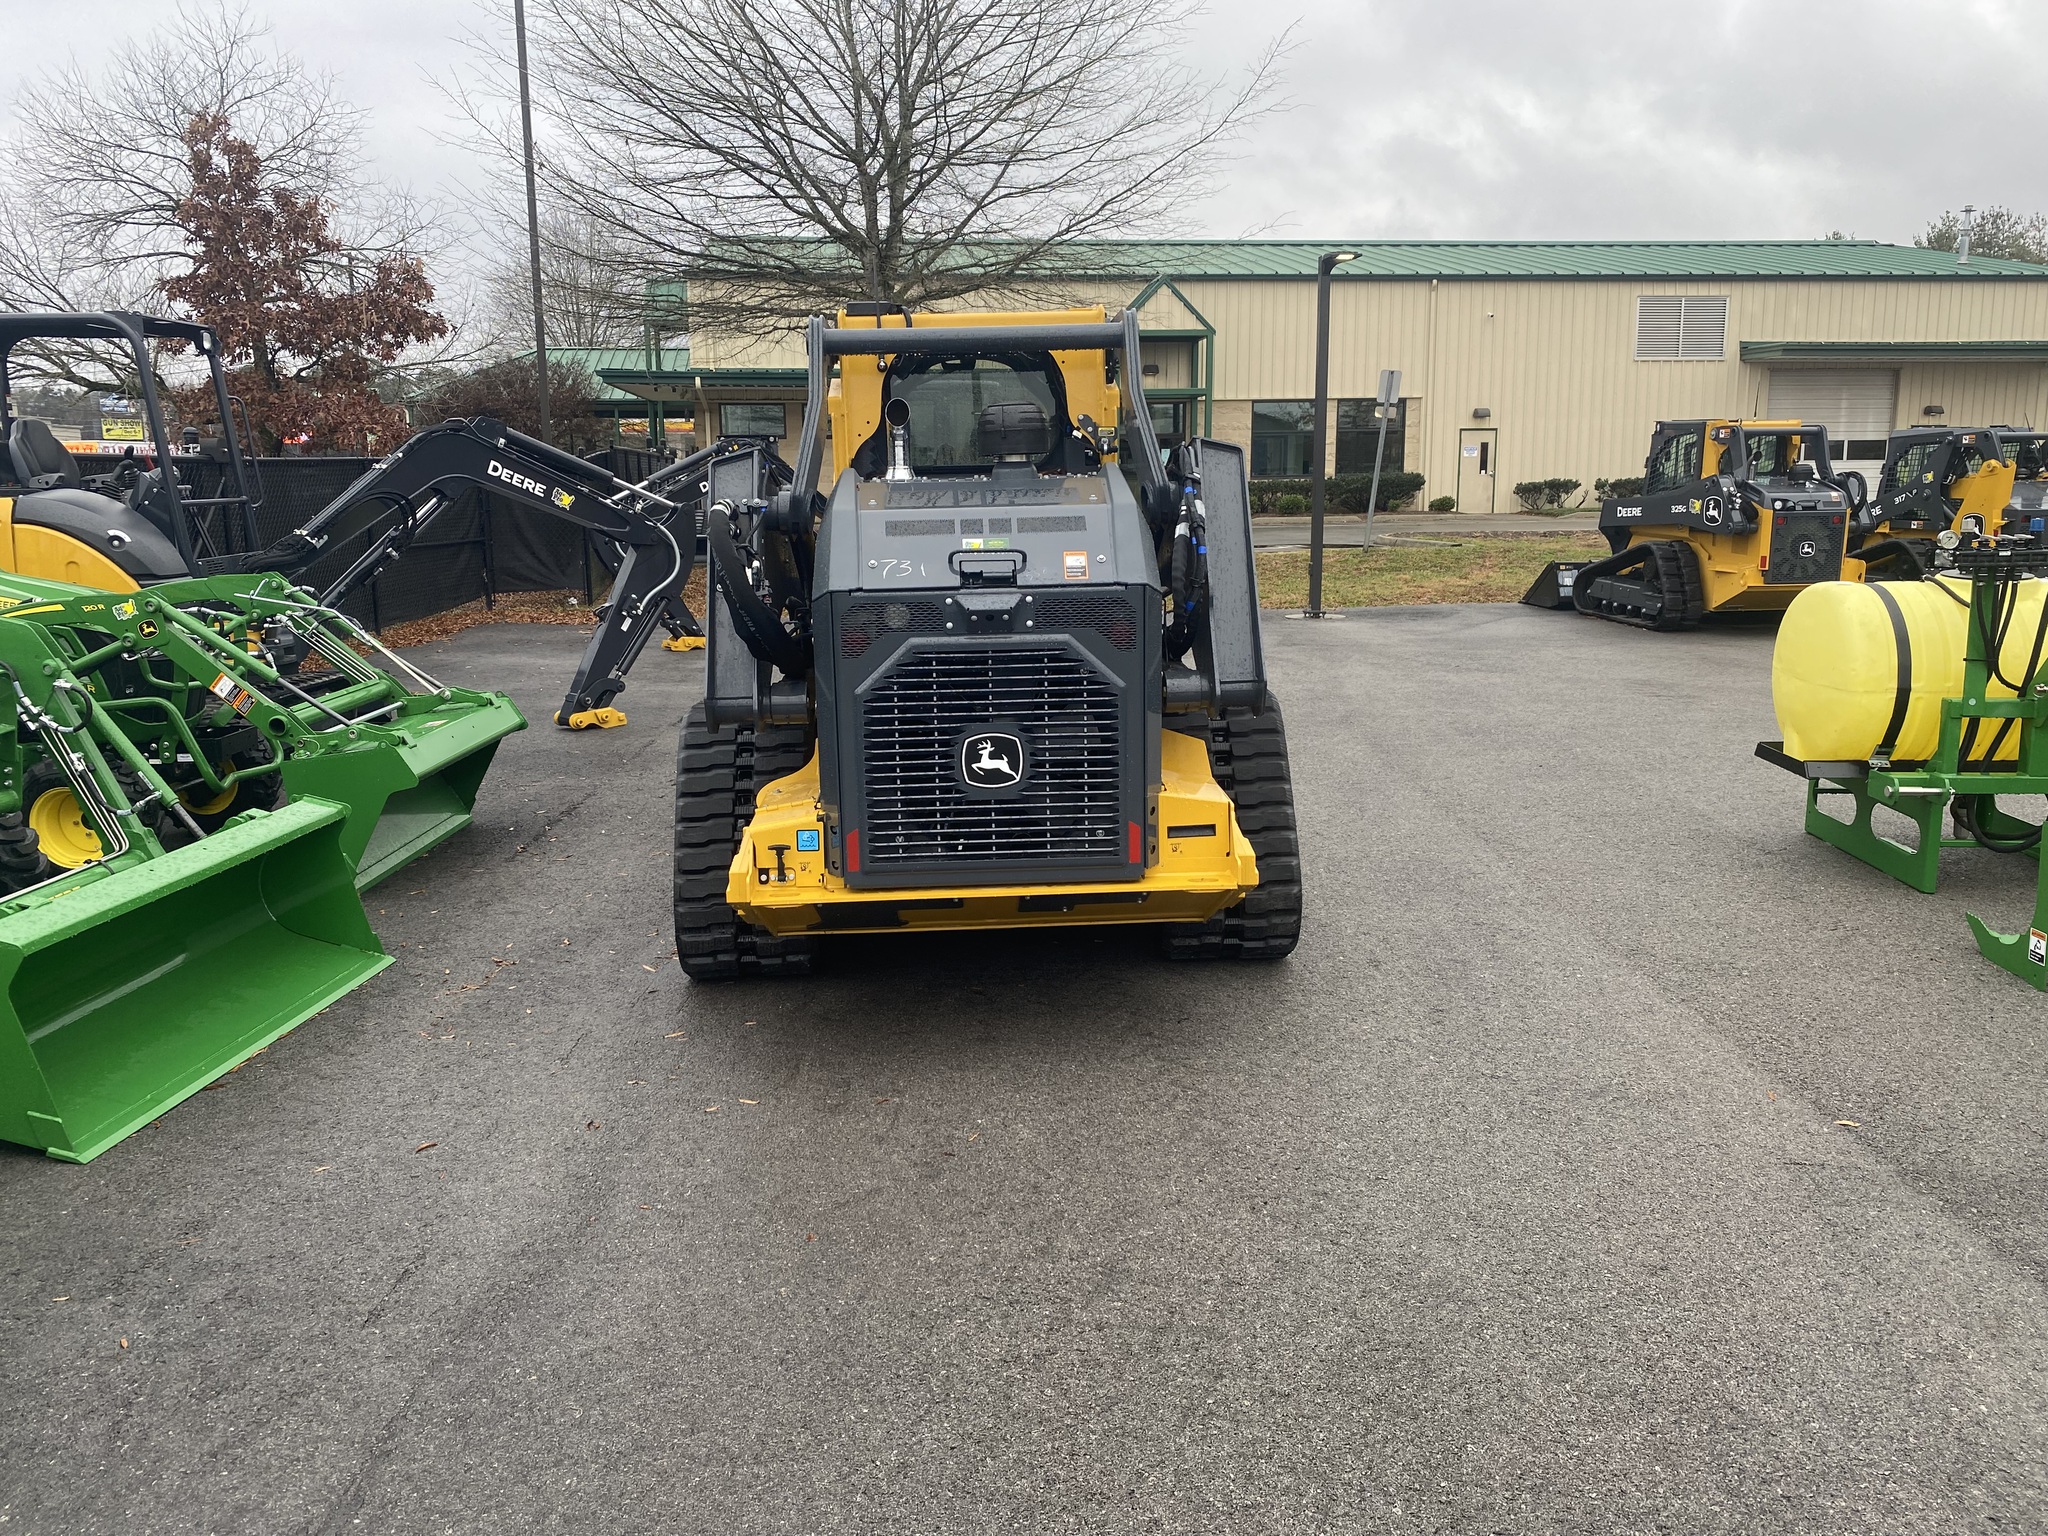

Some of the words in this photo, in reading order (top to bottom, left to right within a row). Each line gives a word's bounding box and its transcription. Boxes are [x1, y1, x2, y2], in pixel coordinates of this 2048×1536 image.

[120, 419, 141, 427] SHOW
[487, 459, 547, 498] DEERE
[1894, 493, 1906, 505] 317
[1617, 506, 1643, 518] DEERE
[1670, 504, 1687, 513] 325G
[879, 558, 927, 580] 731
